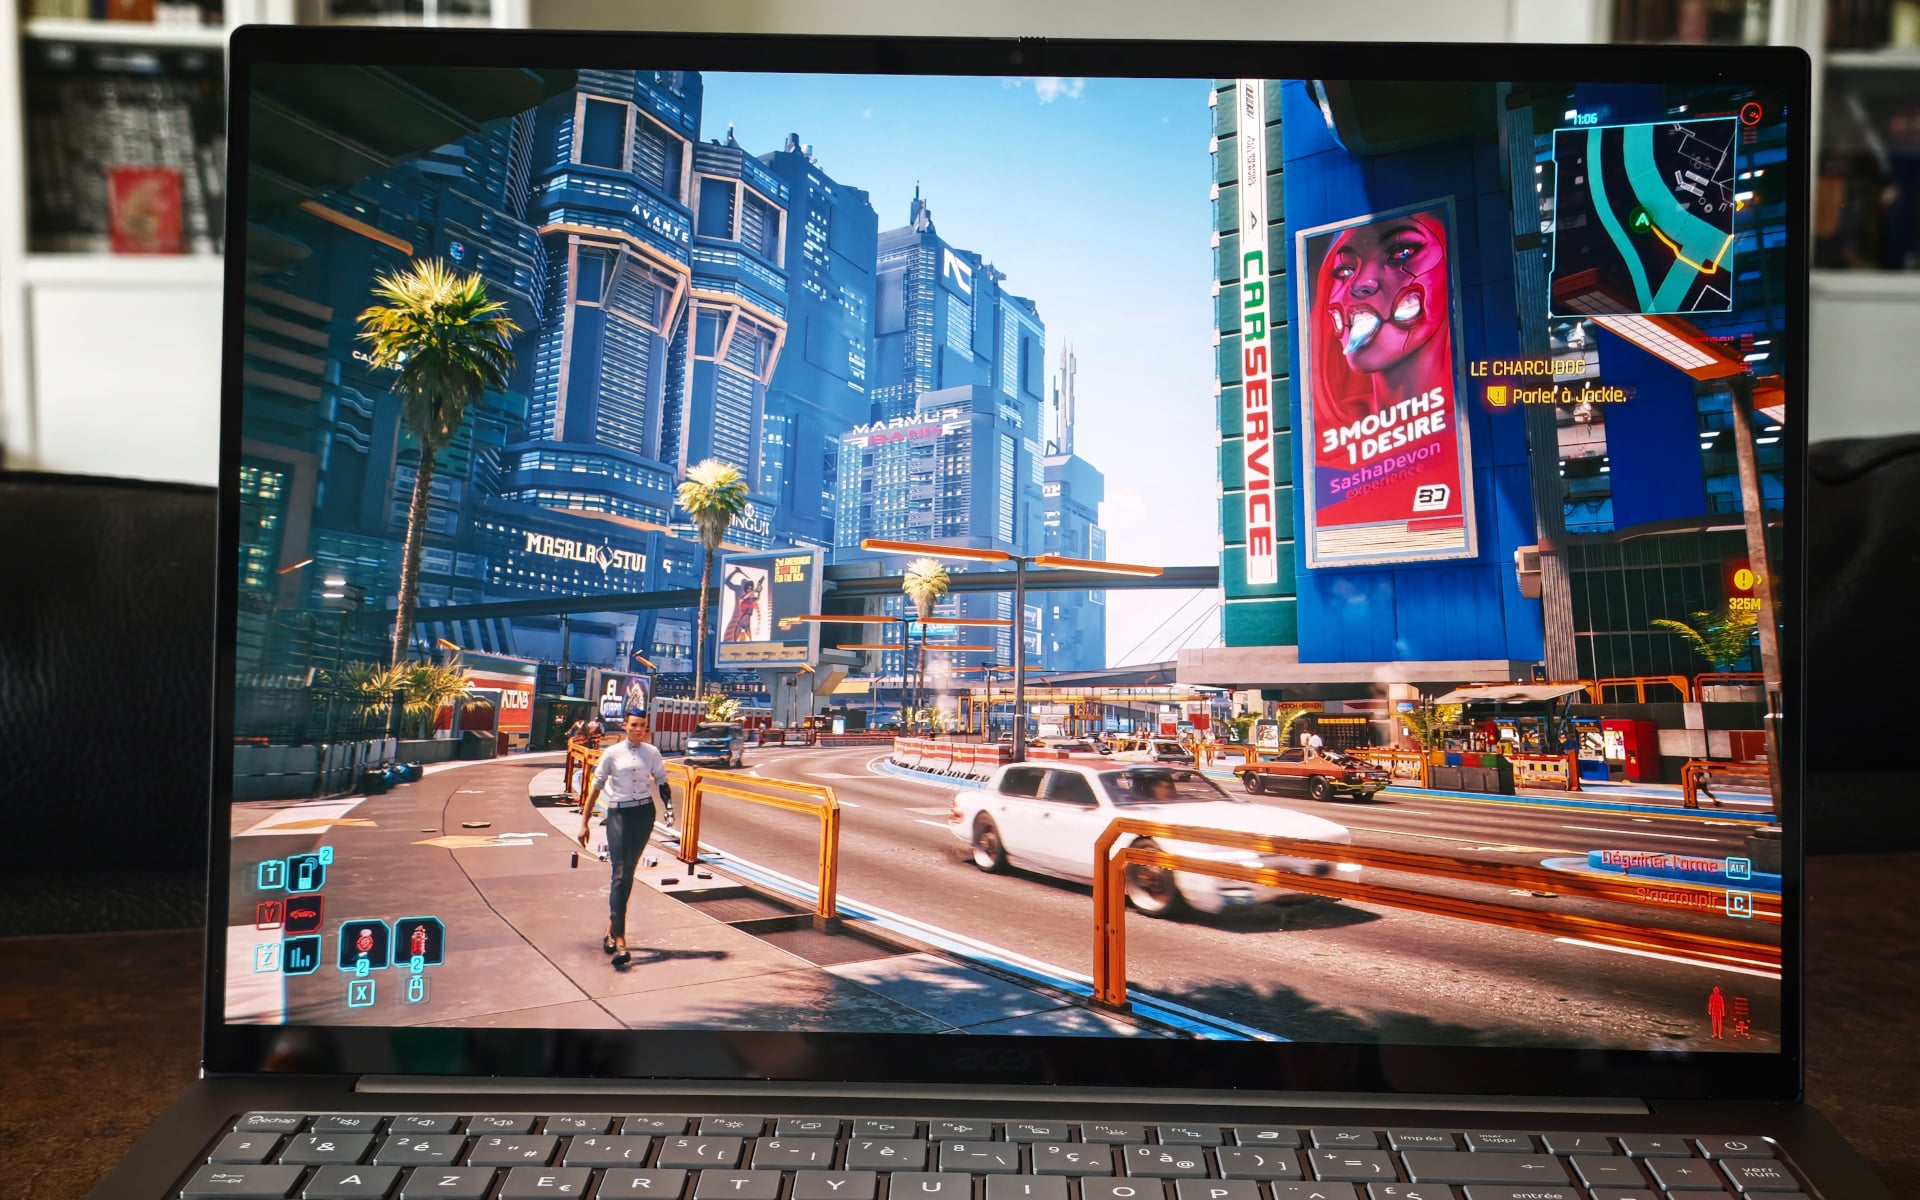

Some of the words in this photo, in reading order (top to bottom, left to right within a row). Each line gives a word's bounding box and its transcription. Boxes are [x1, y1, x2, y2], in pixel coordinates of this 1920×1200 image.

[632, 204, 689, 243] AVANTE
[1471, 361, 1488, 376] LE
[1492, 359, 1586, 376] CHARCUDOC
[1513, 387, 1556, 404] Parler
[1561, 387, 1571, 403] à
[1575, 386, 1627, 404] Jackie.
[853, 408, 959, 435] MARMUR
[525, 532, 597, 564] MASALA
[1729, 597, 1761, 610] 325M
[1730, 864, 1745, 873] ALT
[267, 867, 277, 882] T
[1734, 896, 1744, 911] C
[264, 908, 275, 923] V
[356, 986, 367, 1000] X
[397, 1138, 410, 1146] 2
[489, 1138, 502, 1146] 3
[584, 1138, 596, 1146] 4
[769, 1141, 781, 1149] 6
[953, 1144, 965, 1152] 8
[1048, 1146, 1060, 1154] 9
[339, 1174, 362, 1185] A
[438, 1175, 461, 1186] Z
[537, 1176, 556, 1187] E
[632, 1178, 651, 1189] R
[730, 1179, 749, 1190] T
[826, 1180, 846, 1191] Y
[922, 1181, 941, 1192] U
[1112, 1186, 1136, 1197] O
[1211, 1188, 1228, 1199] P
